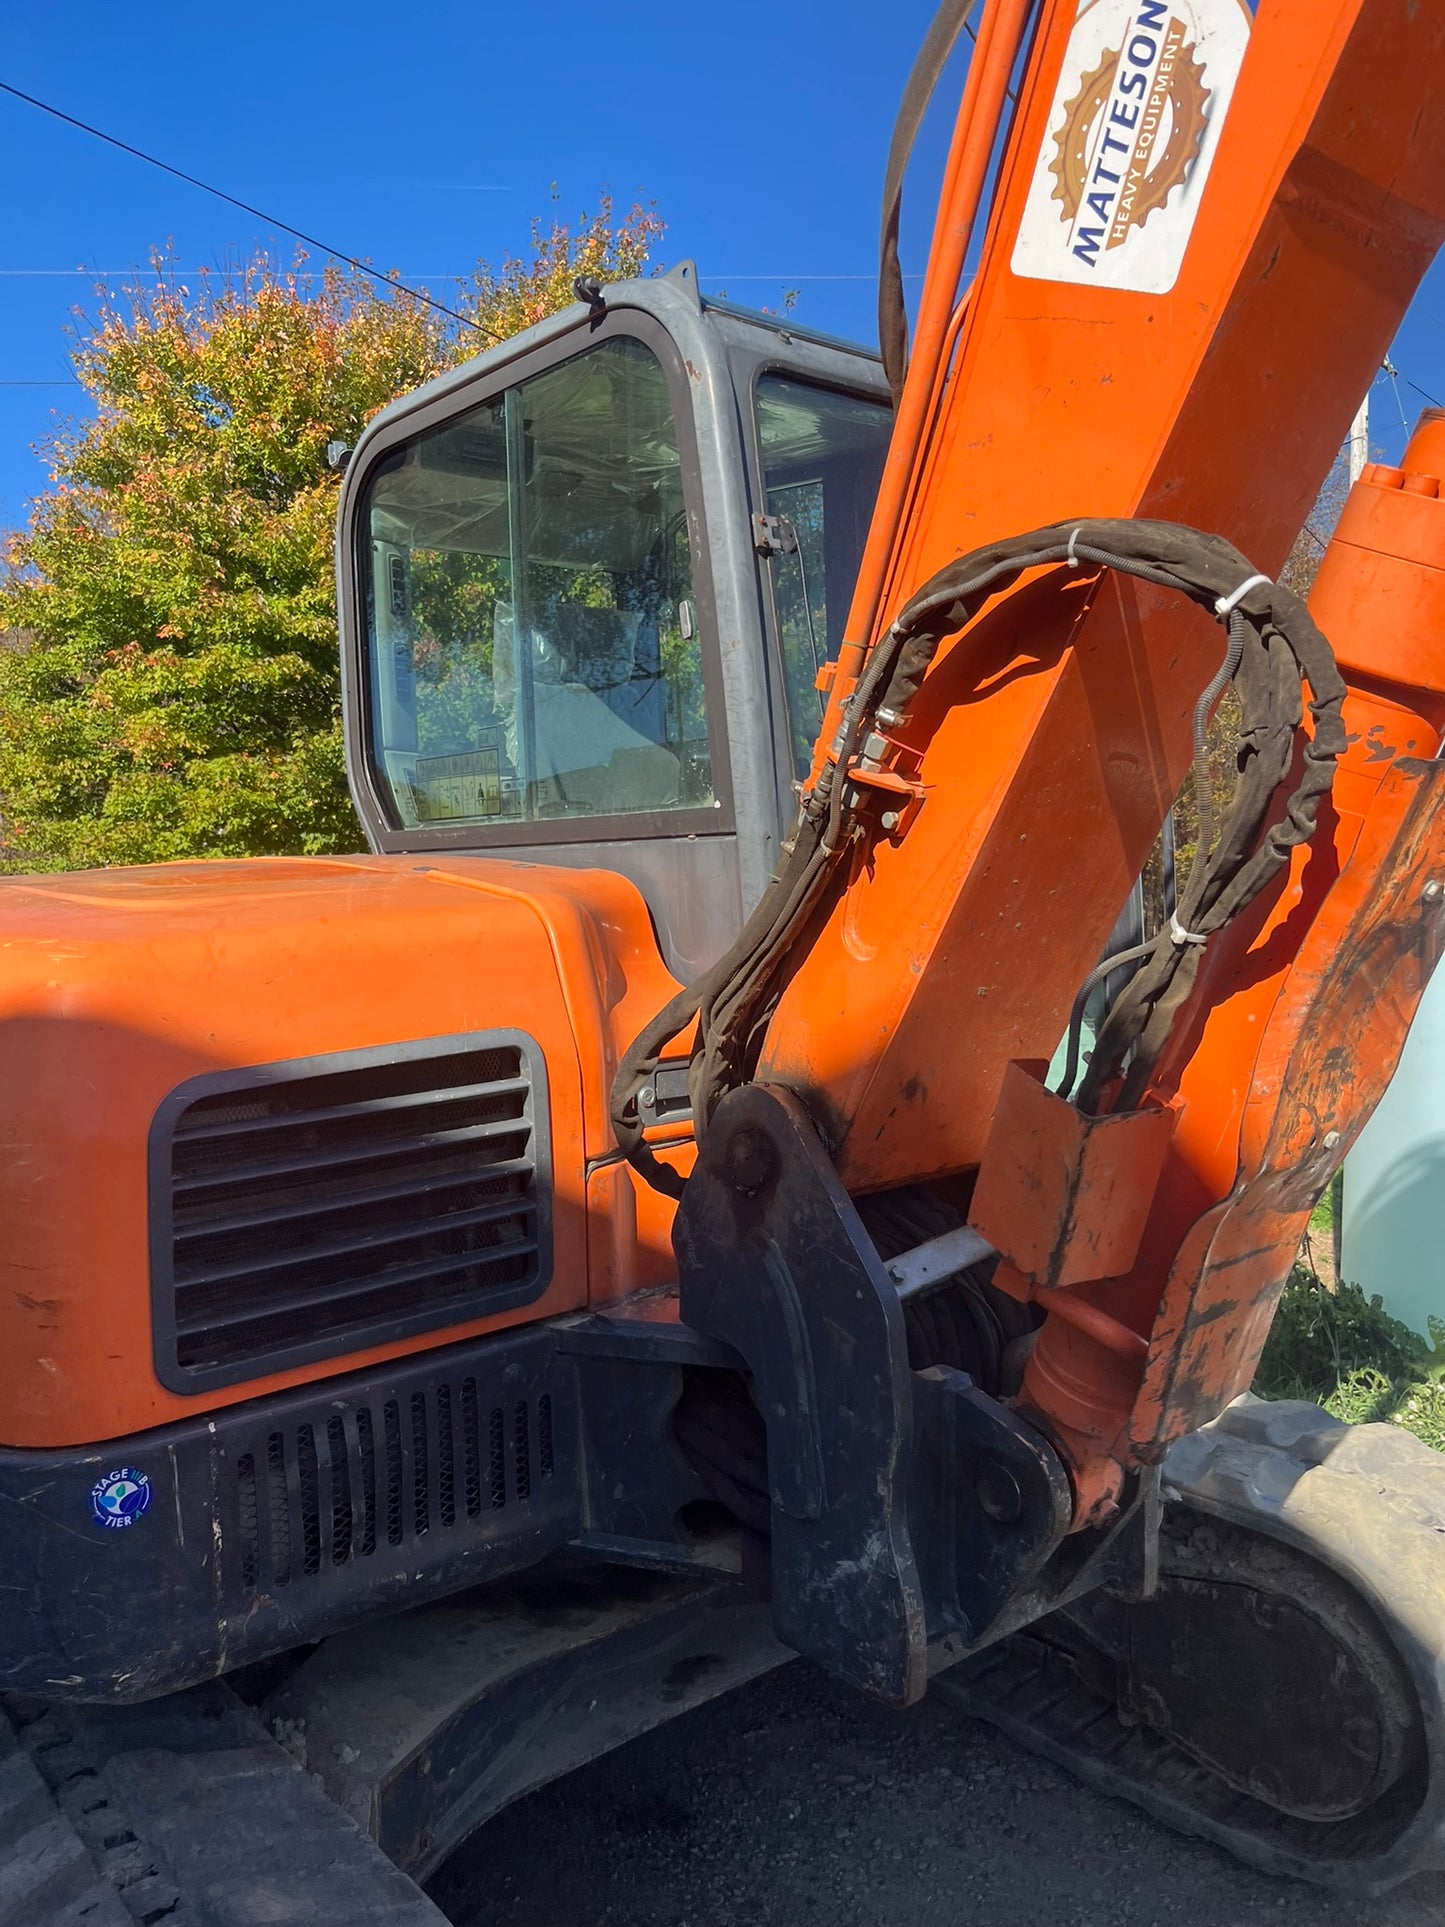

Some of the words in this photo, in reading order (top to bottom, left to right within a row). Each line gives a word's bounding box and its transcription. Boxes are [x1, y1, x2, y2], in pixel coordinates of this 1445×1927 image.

[1072, 0, 1169, 268] MATTESON
[1112, 168, 1142, 239] HEAVY
[1135, 30, 1182, 160] EQUIPMENT
[91, 1468, 129, 1497] STAGE
[105, 1515, 132, 1527] TIER
